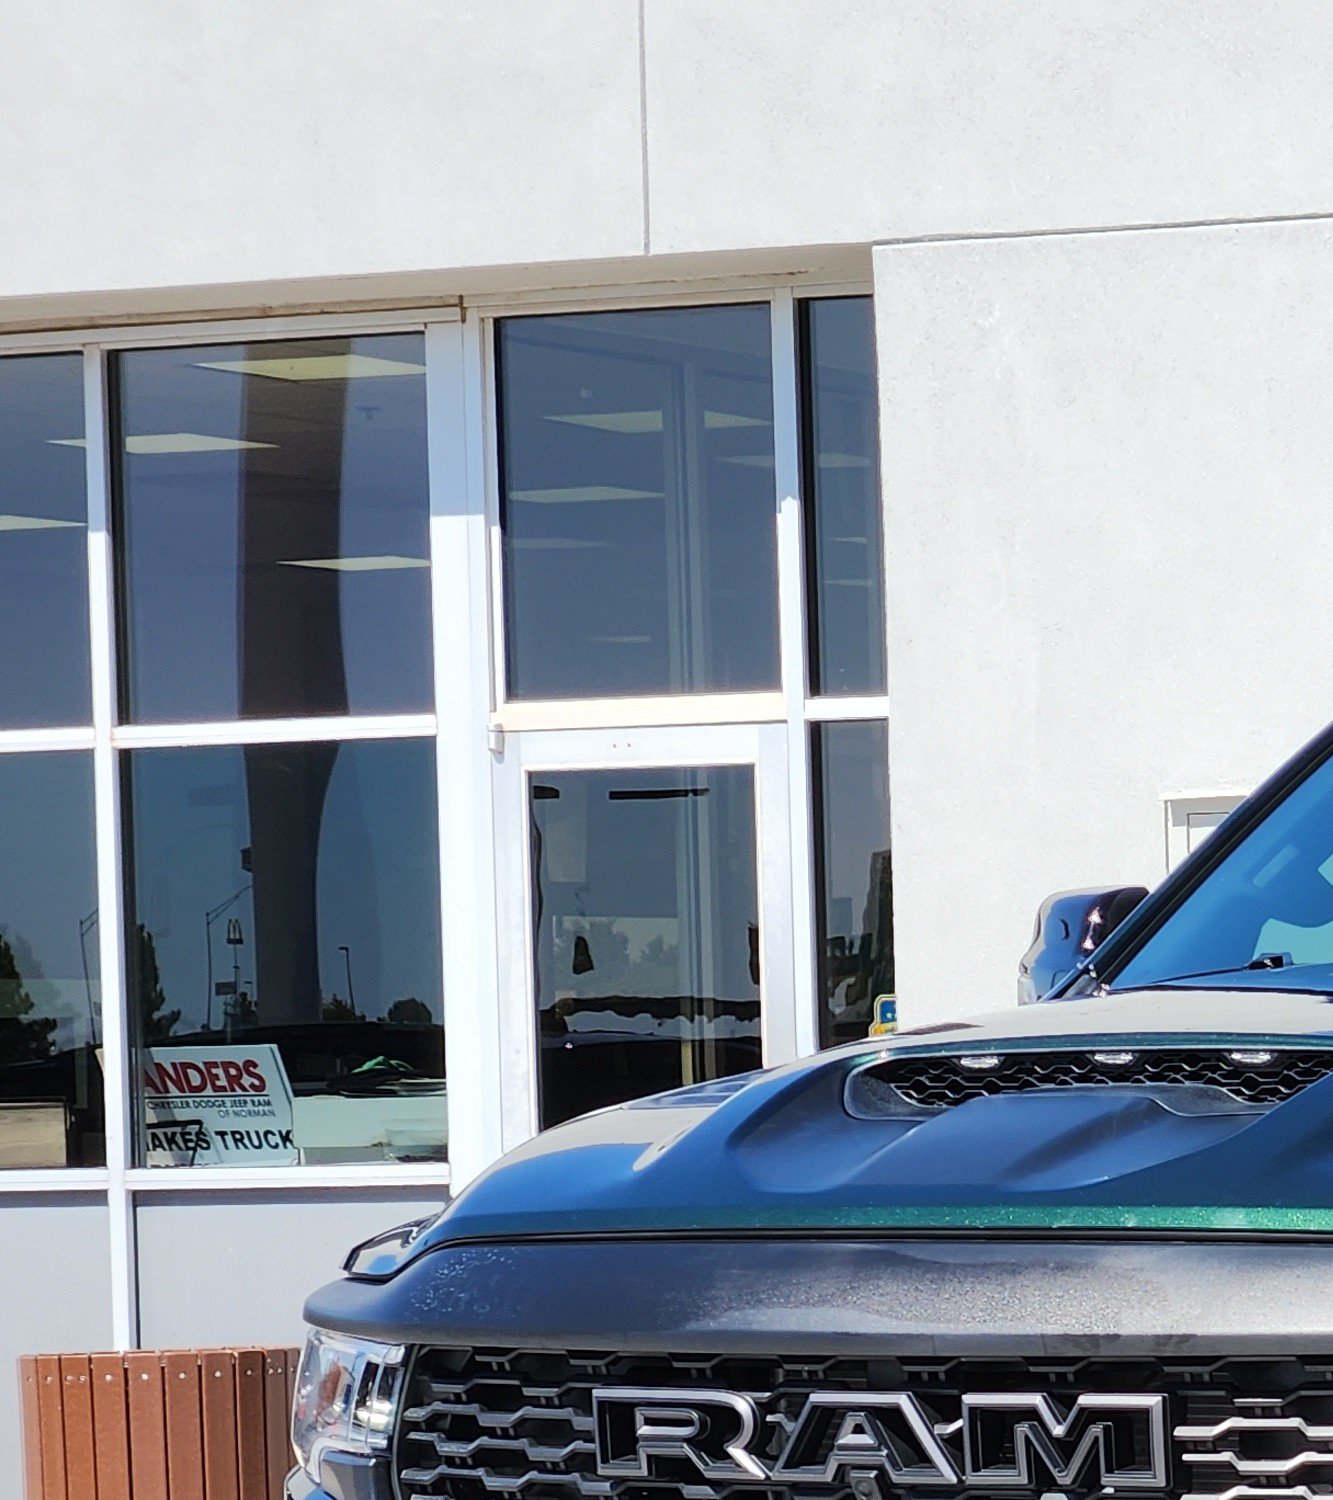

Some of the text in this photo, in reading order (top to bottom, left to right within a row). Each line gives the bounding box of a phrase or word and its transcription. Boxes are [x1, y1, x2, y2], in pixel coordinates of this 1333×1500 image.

[146, 1098, 273, 1110] CHRYSLER DODGE JEEP RAM
[217, 1109, 276, 1119] OF NORMAN
[147, 1129, 294, 1151] AKES TRUCK
[592, 1385, 1173, 1488] RAM
